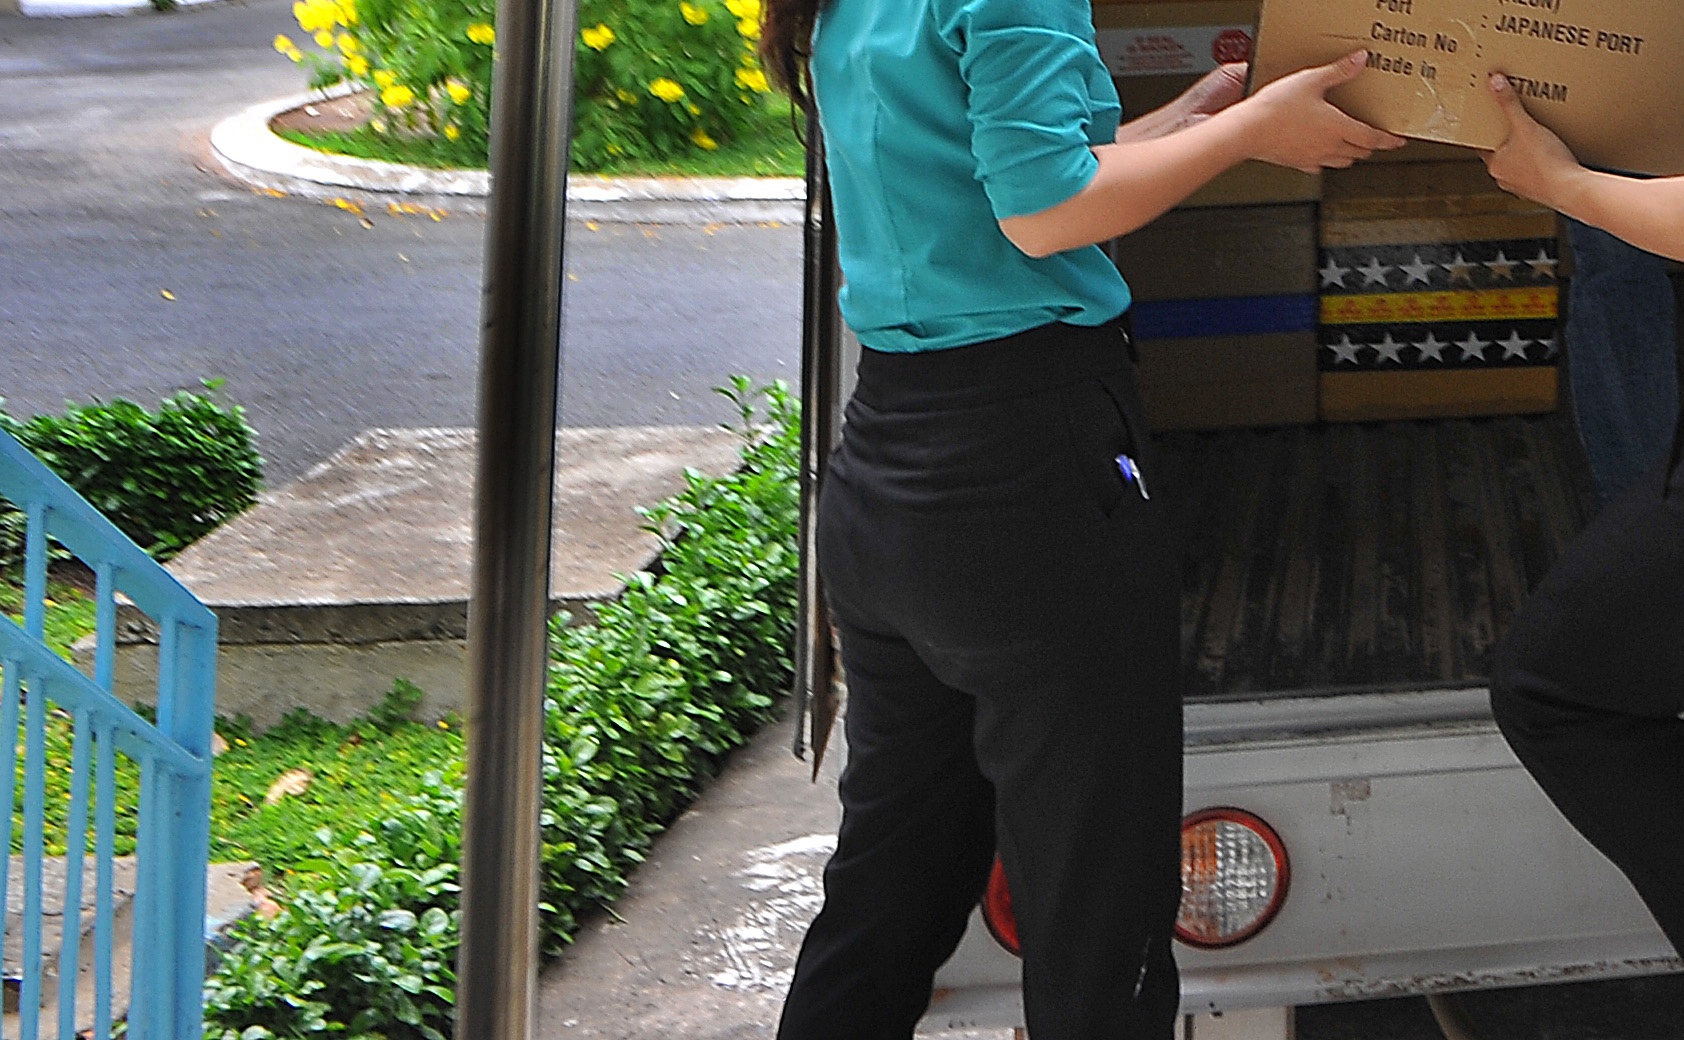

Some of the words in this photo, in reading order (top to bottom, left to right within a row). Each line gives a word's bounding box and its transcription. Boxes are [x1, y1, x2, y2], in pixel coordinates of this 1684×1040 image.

[1371, 21, 1427, 49] Carton
[1494, 14, 1590, 47] JAPANESE
[1596, 31, 1644, 55] PORT
[1365, 50, 1413, 76] Made
[1420, 61, 1437, 80] in
